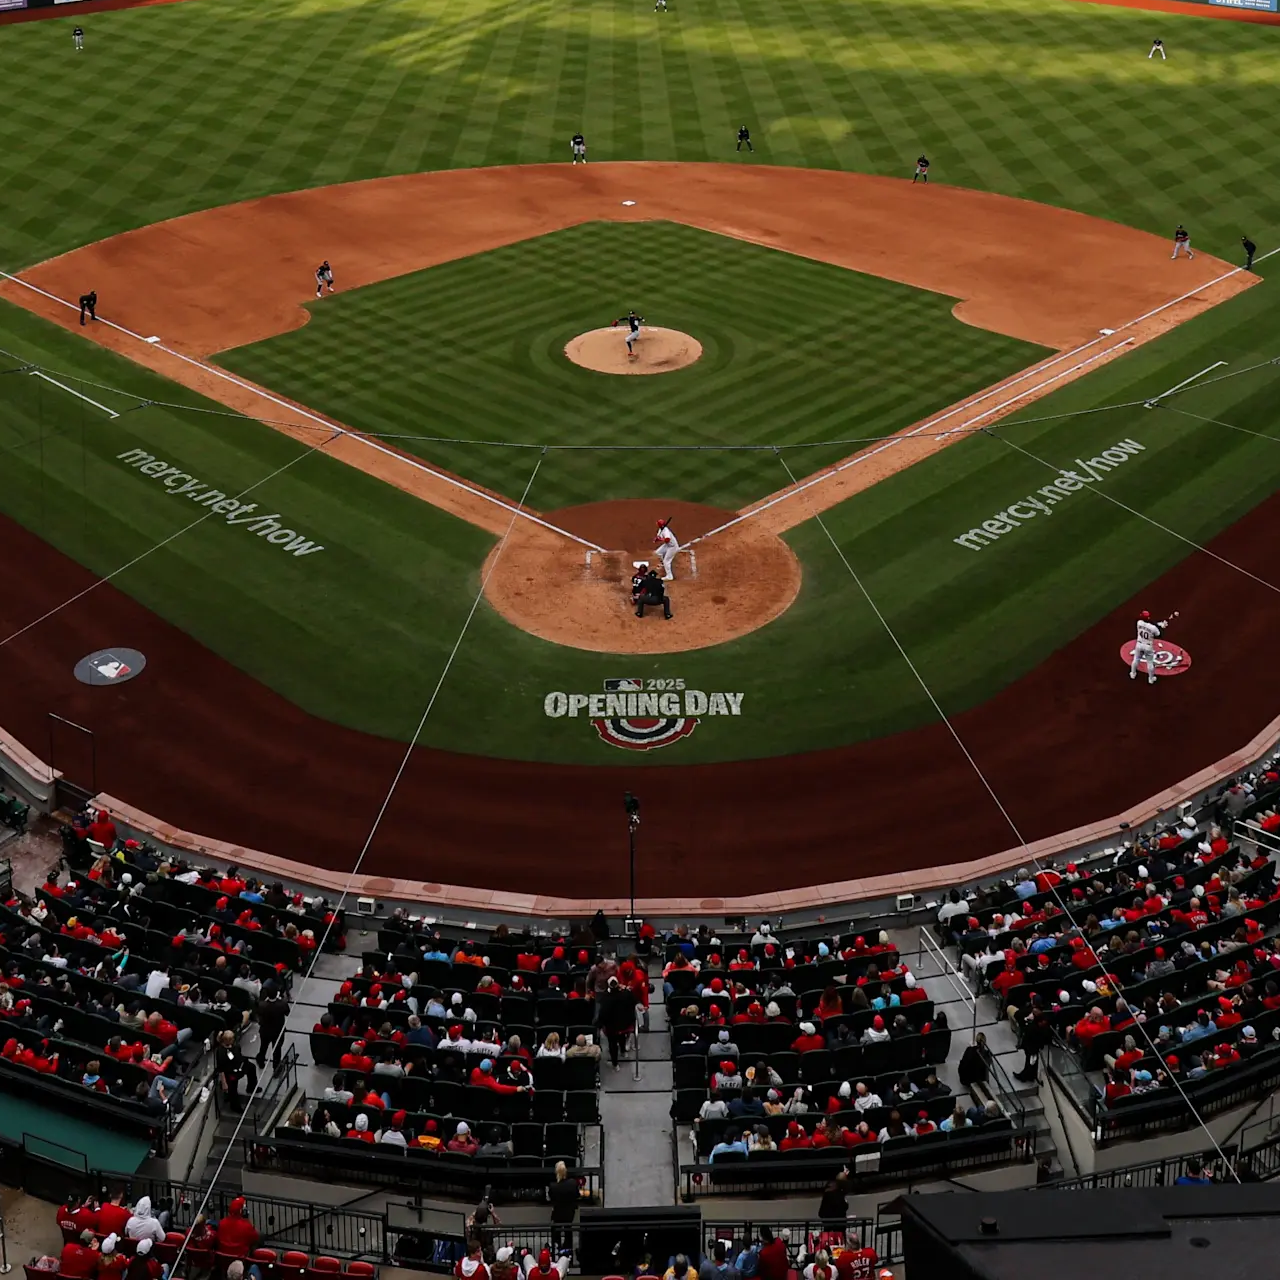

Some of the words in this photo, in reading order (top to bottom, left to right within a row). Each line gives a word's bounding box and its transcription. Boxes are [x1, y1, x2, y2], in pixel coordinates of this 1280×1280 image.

[116, 448, 325, 557] mercy.net/now
[953, 438, 1147, 551] mercy.net/now
[544, 691, 680, 718] OPENING
[685, 690, 744, 716] DAY
[647, 678, 686, 691] 2025
